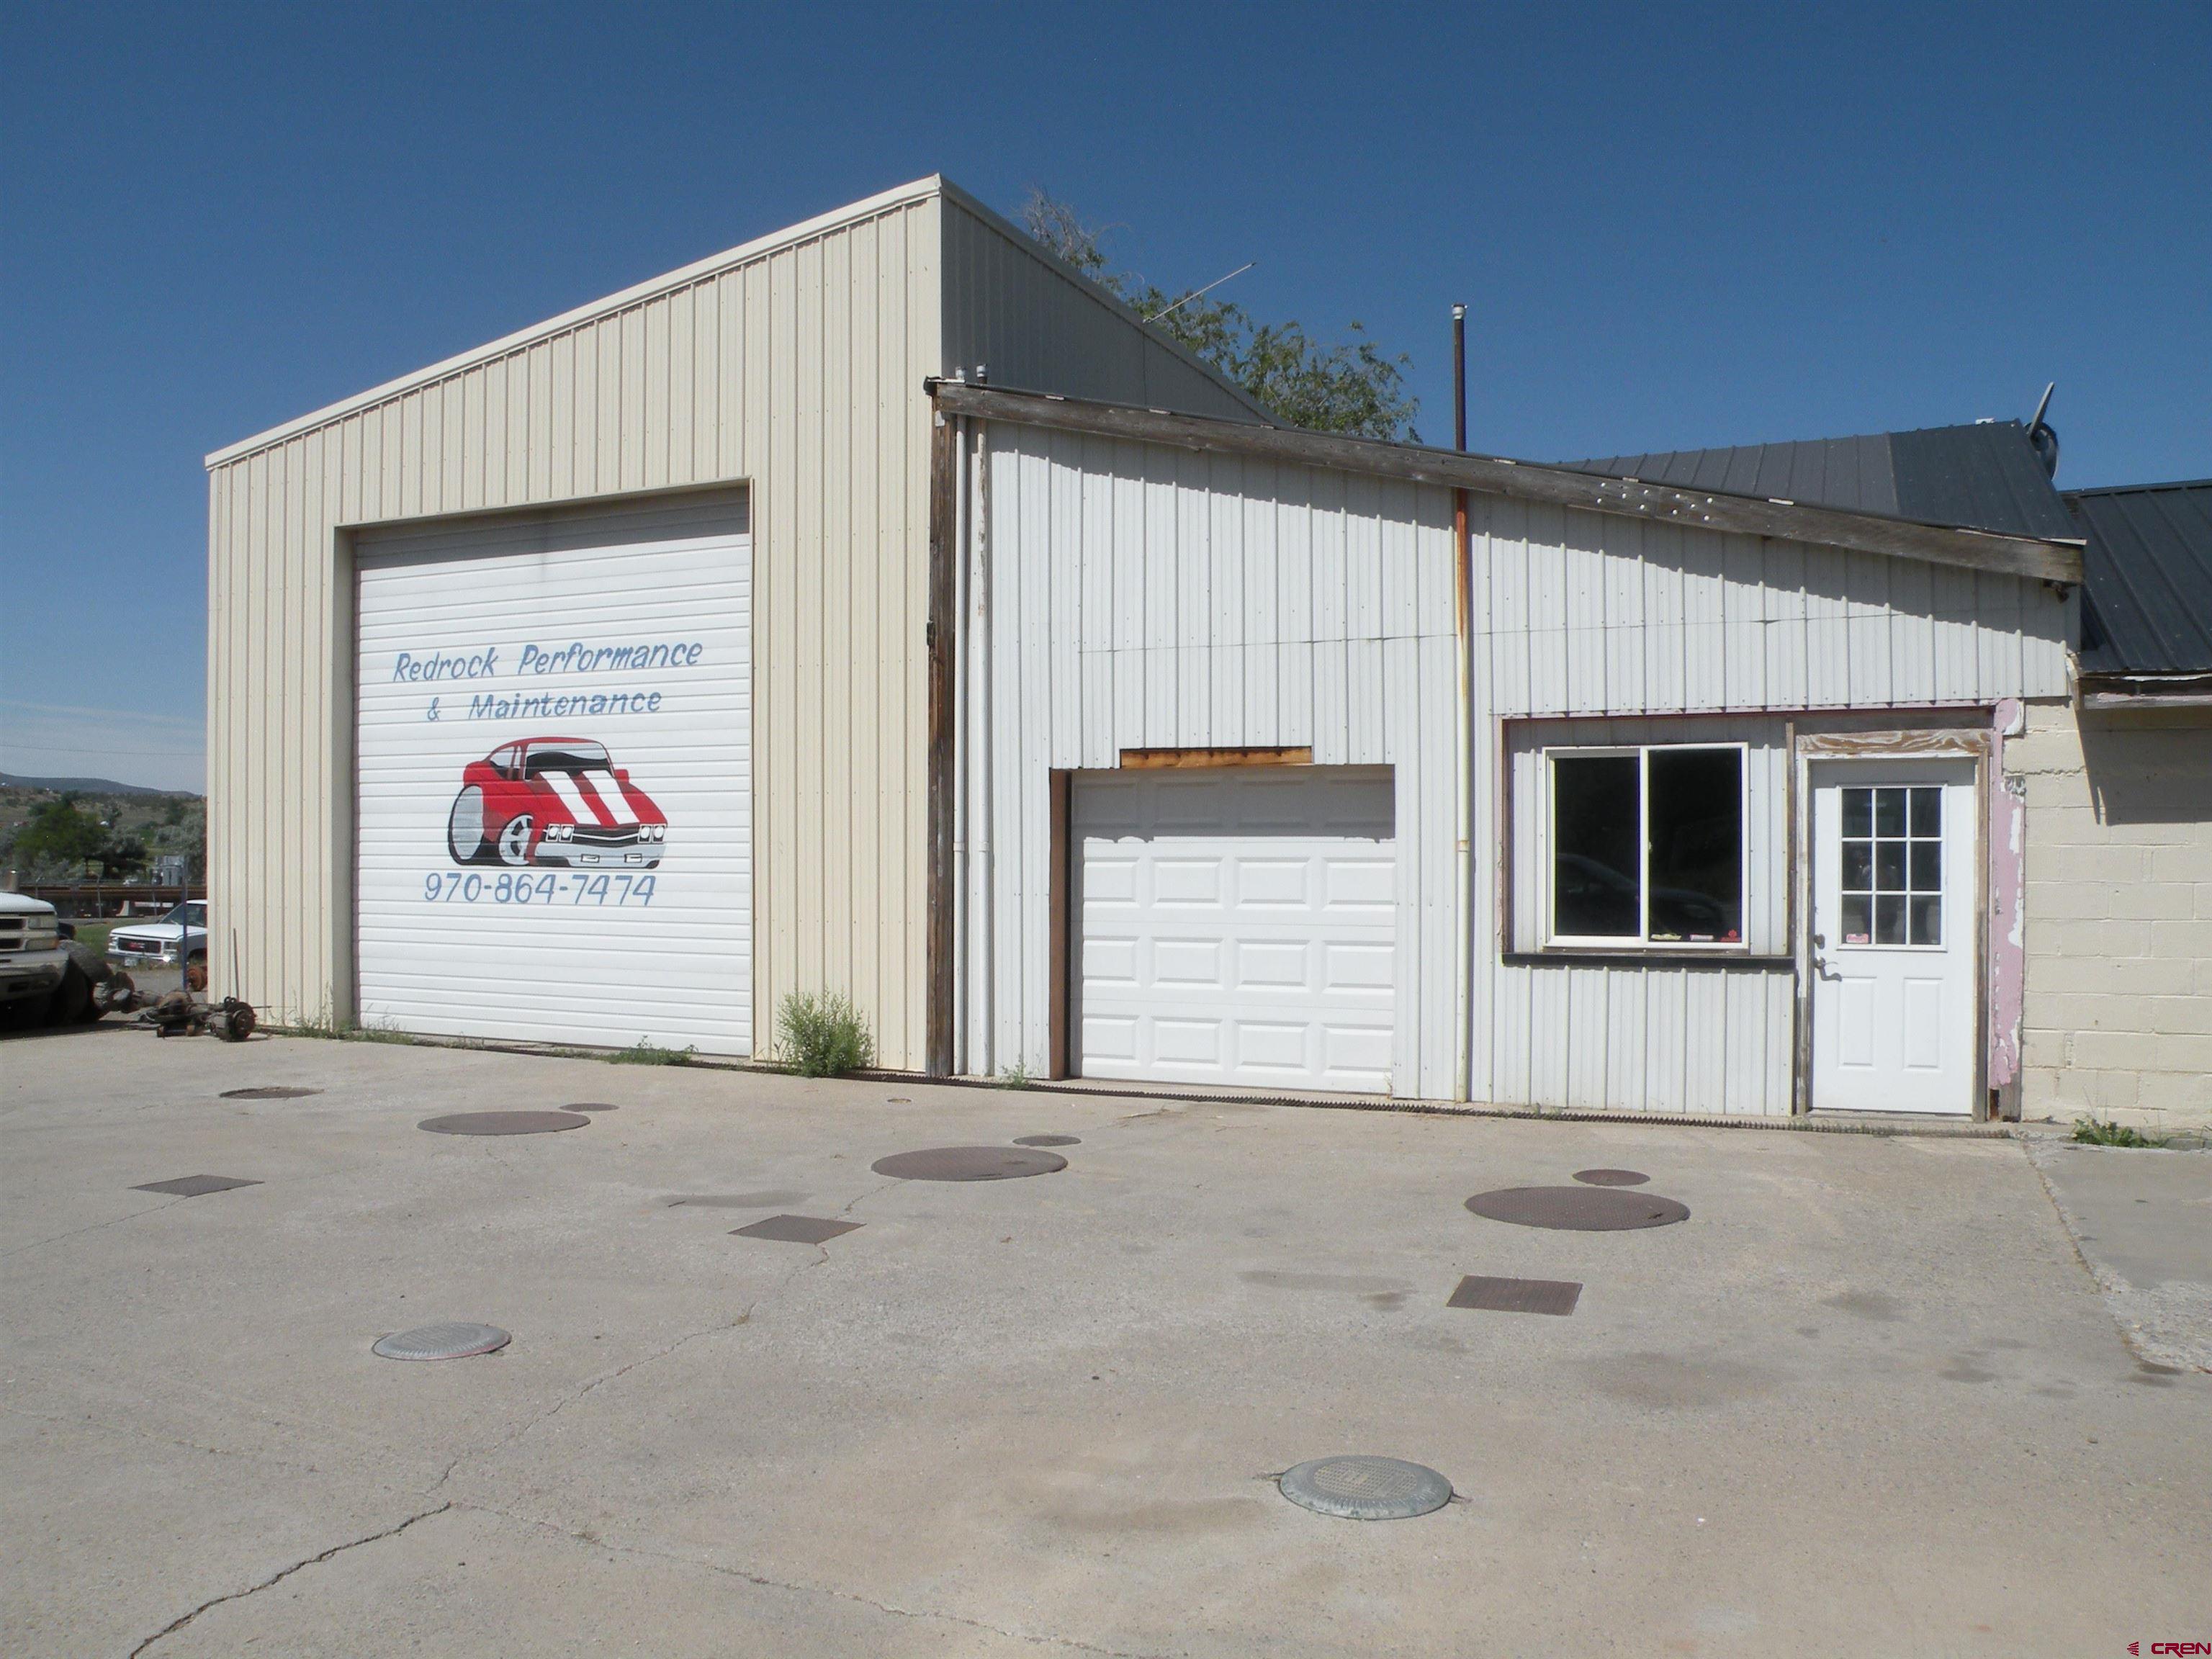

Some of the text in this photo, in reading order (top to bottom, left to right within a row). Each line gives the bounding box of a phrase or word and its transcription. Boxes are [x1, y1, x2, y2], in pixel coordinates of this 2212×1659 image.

[394, 642, 703, 682] Redrock Performance
[426, 691, 662, 721] & Maintenance
[424, 872, 657, 906] 970-864-7474
